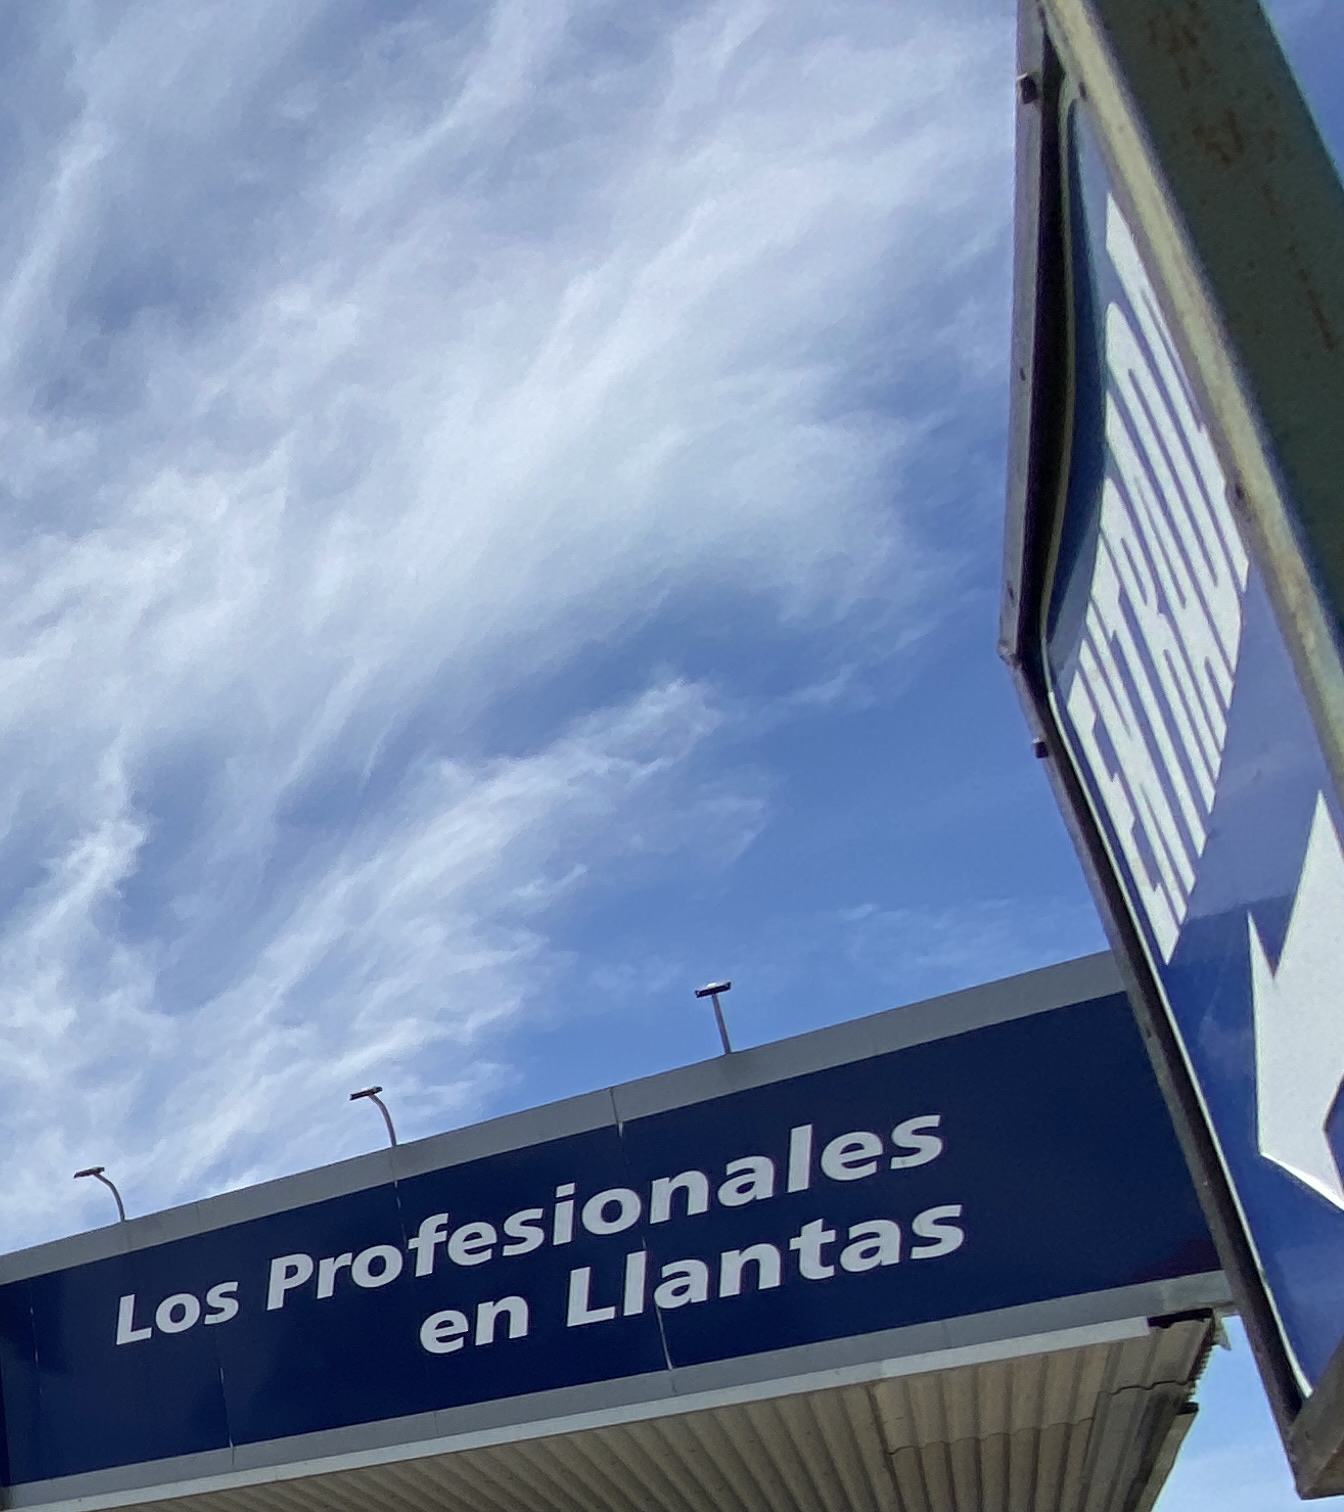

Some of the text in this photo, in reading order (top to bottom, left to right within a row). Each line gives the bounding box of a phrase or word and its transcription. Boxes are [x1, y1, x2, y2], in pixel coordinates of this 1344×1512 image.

[115, 1114, 944, 1345] Los Profesionales
[419, 1204, 965, 1355] en Llantas
